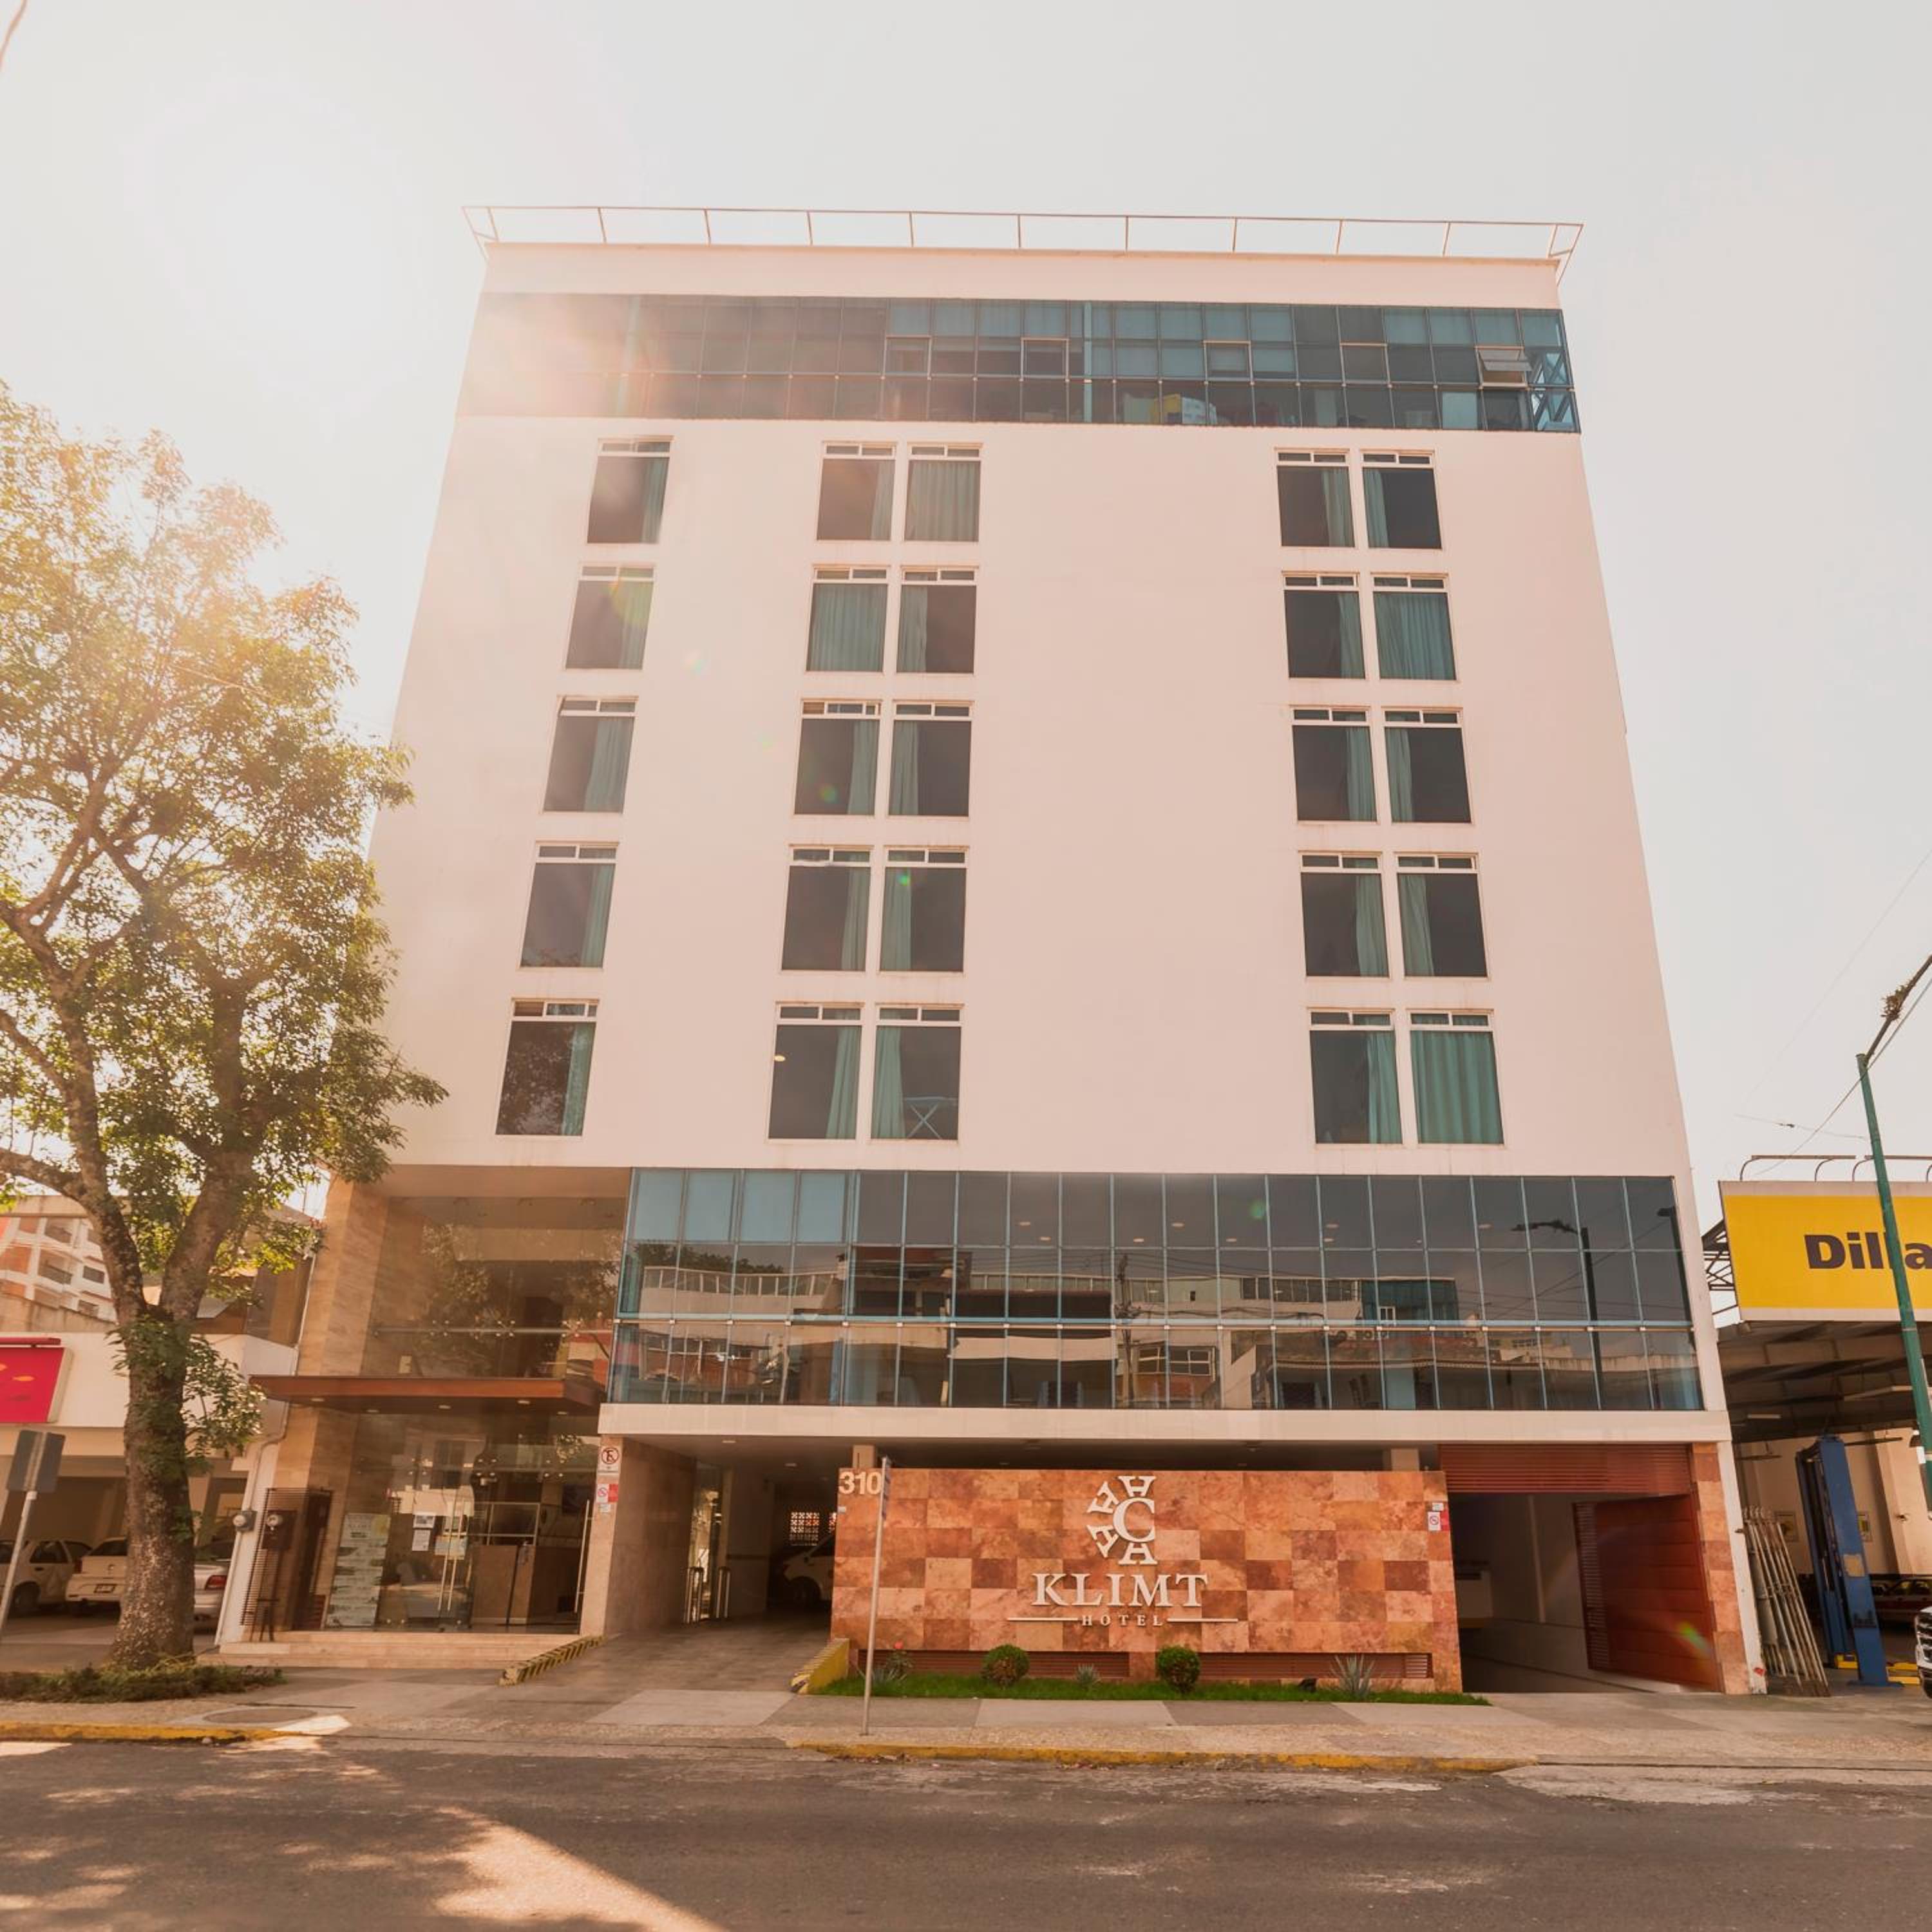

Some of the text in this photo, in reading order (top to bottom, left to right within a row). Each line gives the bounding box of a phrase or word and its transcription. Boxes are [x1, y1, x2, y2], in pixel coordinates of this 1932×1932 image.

[1804, 1231, 1932, 1269] Dila
[838, 1472, 882, 1495] 310
[1031, 1573, 1208, 1607] KLIMT
[1082, 1615, 1163, 1626] HOTEL
